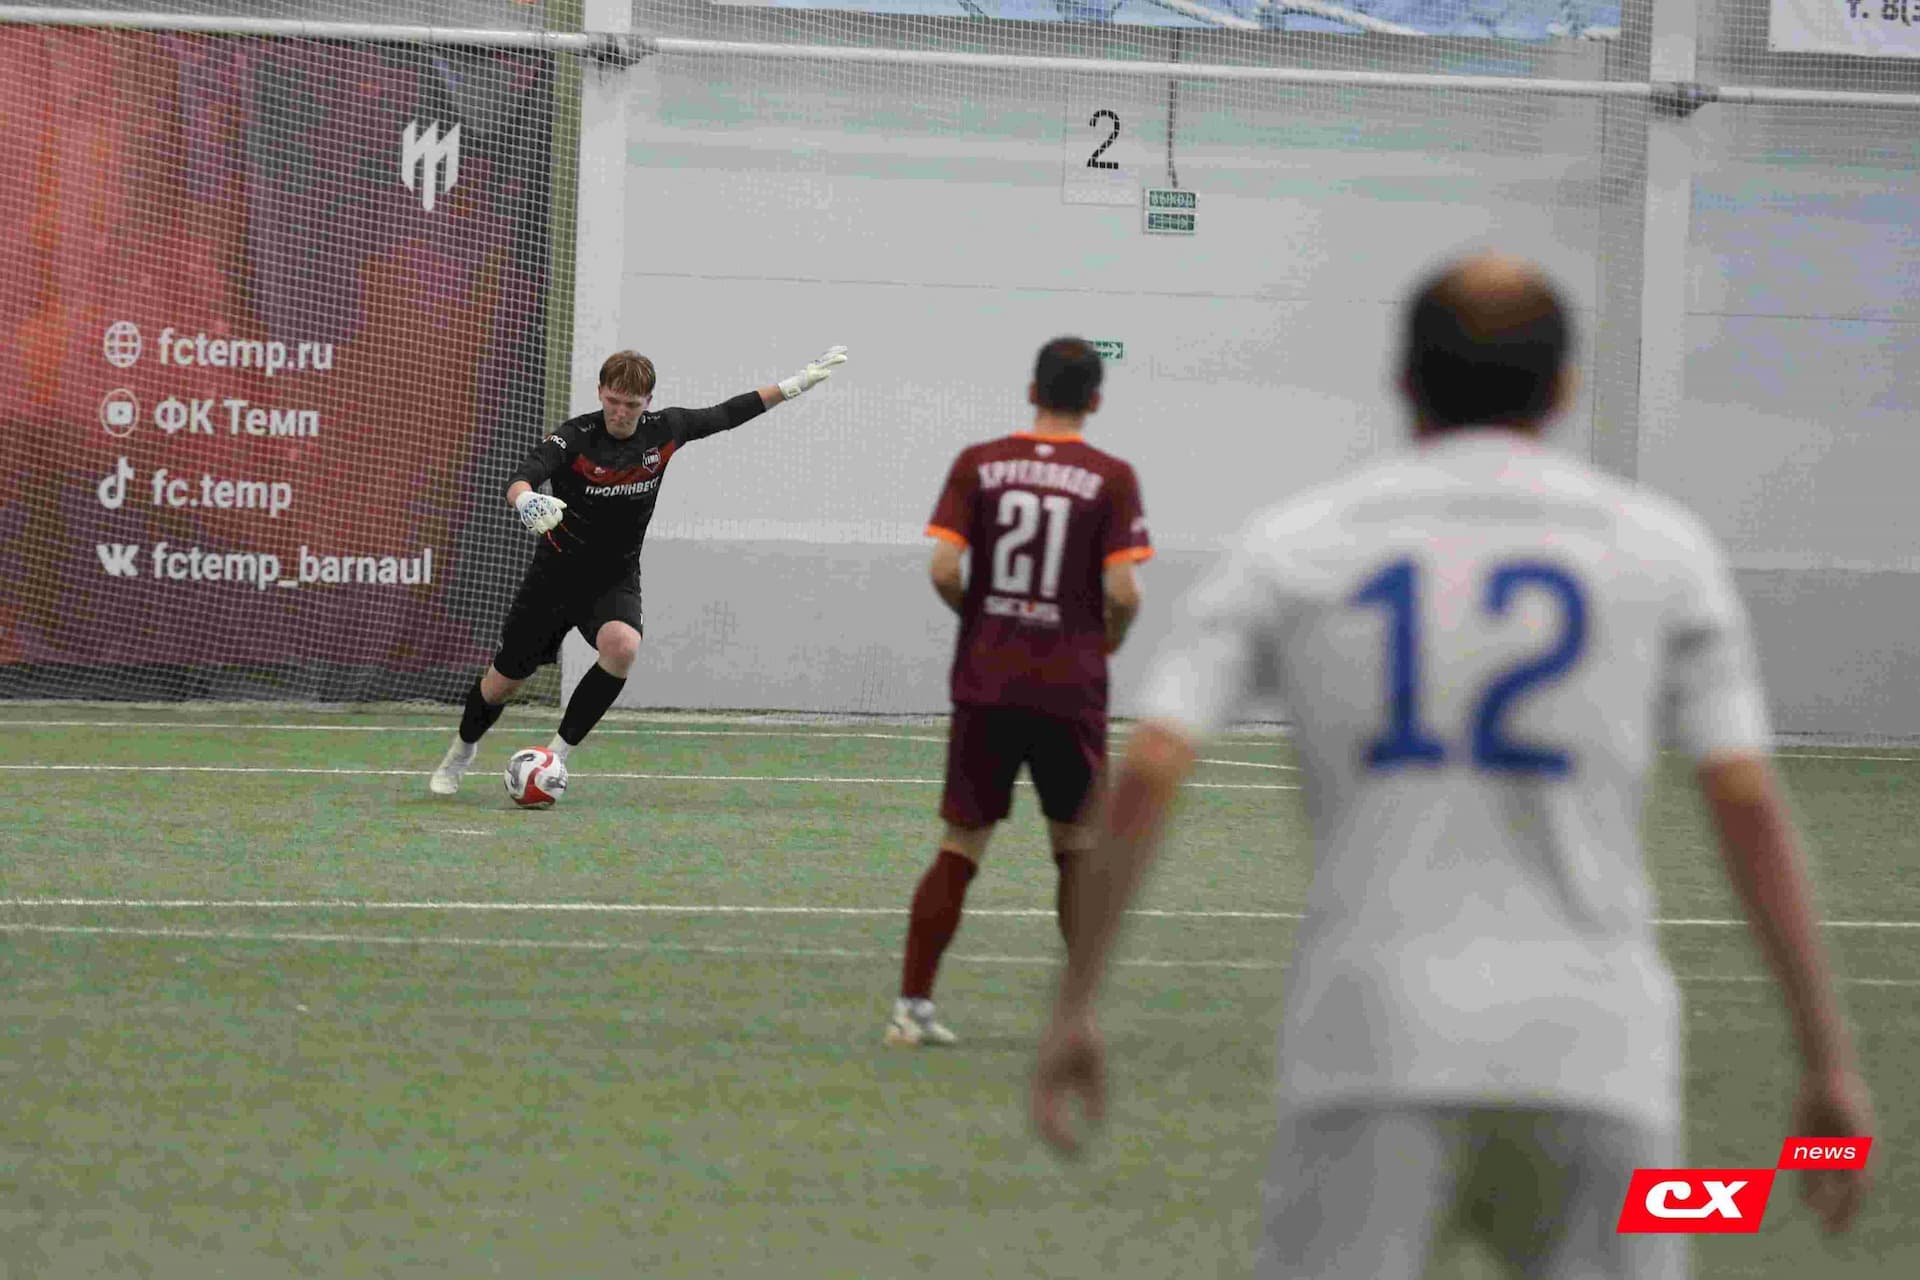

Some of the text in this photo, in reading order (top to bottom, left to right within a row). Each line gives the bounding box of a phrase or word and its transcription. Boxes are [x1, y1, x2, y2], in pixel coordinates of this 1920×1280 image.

[1087, 108, 1121, 170] 2
[158, 327, 334, 375] fctemp.ru
[153, 398, 319, 437] ФК Темп
[151, 468, 293, 517] fc.temp
[152, 541, 433, 591] fctemp_barnaul
[992, 489, 1073, 599] 21
[1349, 556, 1588, 774] 12
